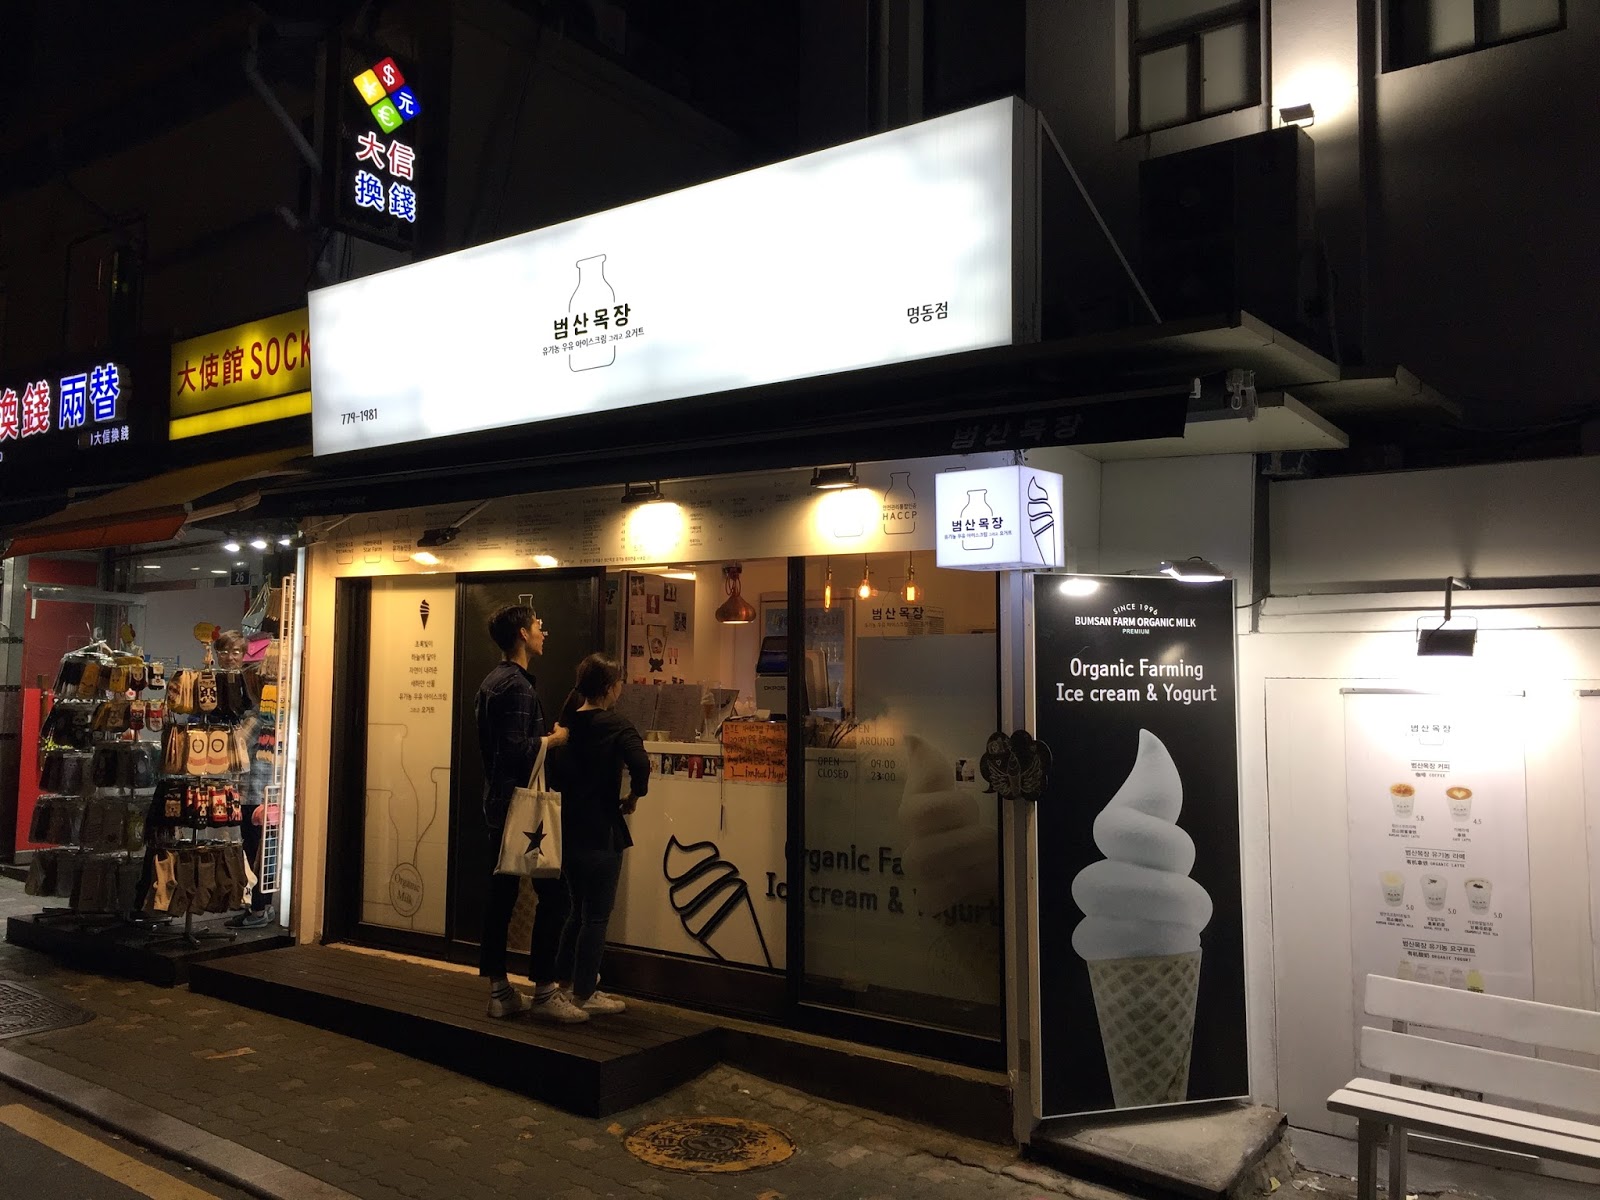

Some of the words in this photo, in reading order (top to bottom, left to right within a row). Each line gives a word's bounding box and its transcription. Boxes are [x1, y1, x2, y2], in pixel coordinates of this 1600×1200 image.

[907, 301, 948, 324] 명동점
[554, 303, 631, 340] 범산목장
[575, 334, 607, 348] 아이스크림
[625, 327, 644, 338] 요거트
[177, 345, 244, 397] 大使館
[59, 363, 121, 430] 兩替
[341, 408, 379, 425] 779-1981
[883, 511, 917, 520] HACCP
[952, 517, 1003, 532] 범산목장
[872, 606, 924, 622] 범산목장
[1112, 603, 1136, 615] SINCE
[1139, 604, 1158, 616] 1996
[1074, 616, 1111, 626] BUMSAN
[1112, 616, 1136, 627] FARM
[1137, 617, 1175, 627] ORGANIC
[1176, 618, 1196, 628] MILK
[1070, 658, 1134, 681] Organic
[1139, 659, 1203, 681] Farming
[1056, 682, 1084, 701] Ice
[1090, 686, 1140, 701] cream
[1146, 683, 1158, 701] &
[1163, 683, 1217, 705] Yogurt
[870, 759, 896, 769] 09:00
[817, 768, 849, 779] CLOSED
[1432, 851, 1450, 859] 유기농
[808, 886, 878, 911] cream
[1402, 940, 1426, 949] 범산목장
[1429, 943, 1447, 951] 유기농
